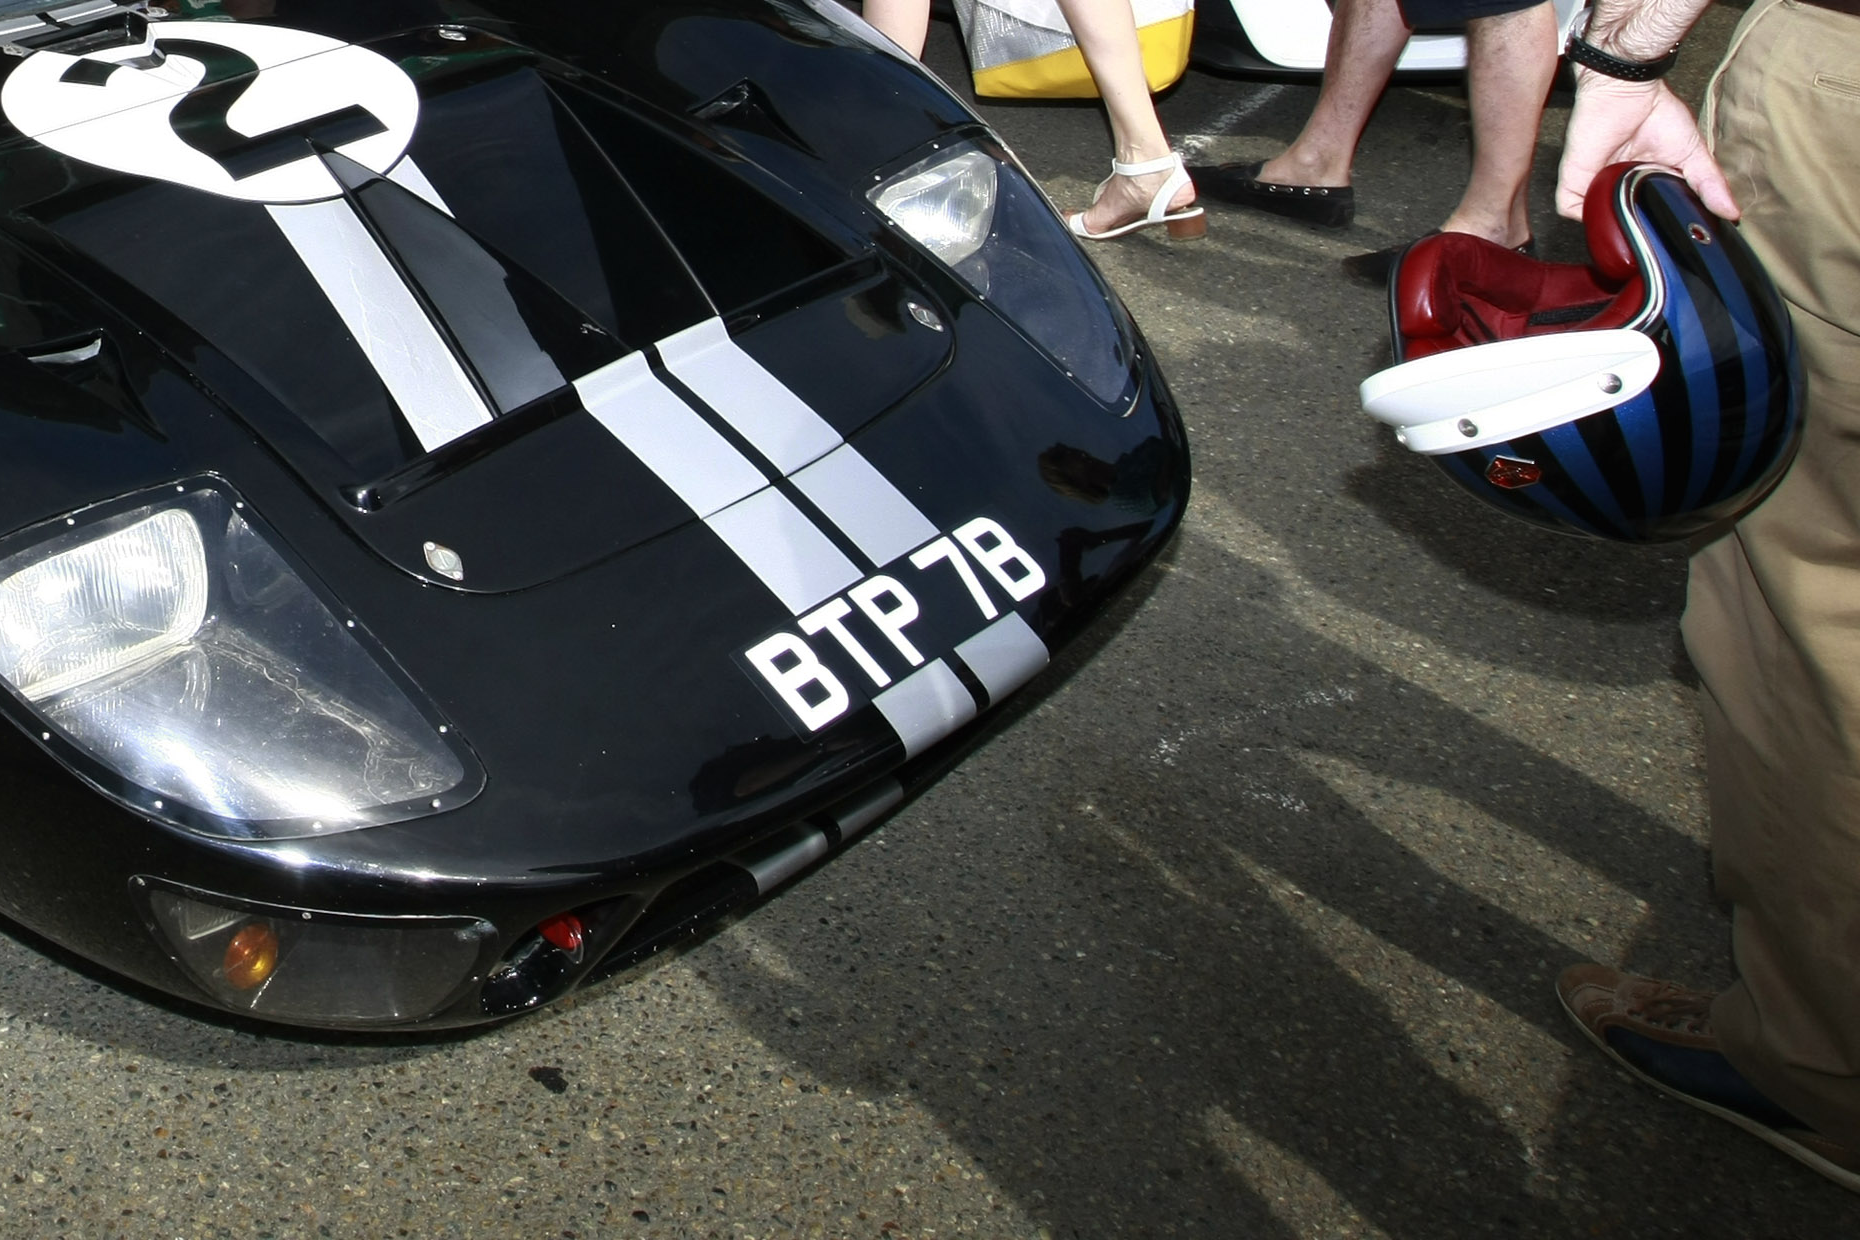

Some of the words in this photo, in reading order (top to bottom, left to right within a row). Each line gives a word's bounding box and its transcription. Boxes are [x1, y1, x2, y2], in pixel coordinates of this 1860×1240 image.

[60, 38, 389, 181] 2
[744, 574, 927, 733] BTP
[917, 515, 1047, 621] 7B
